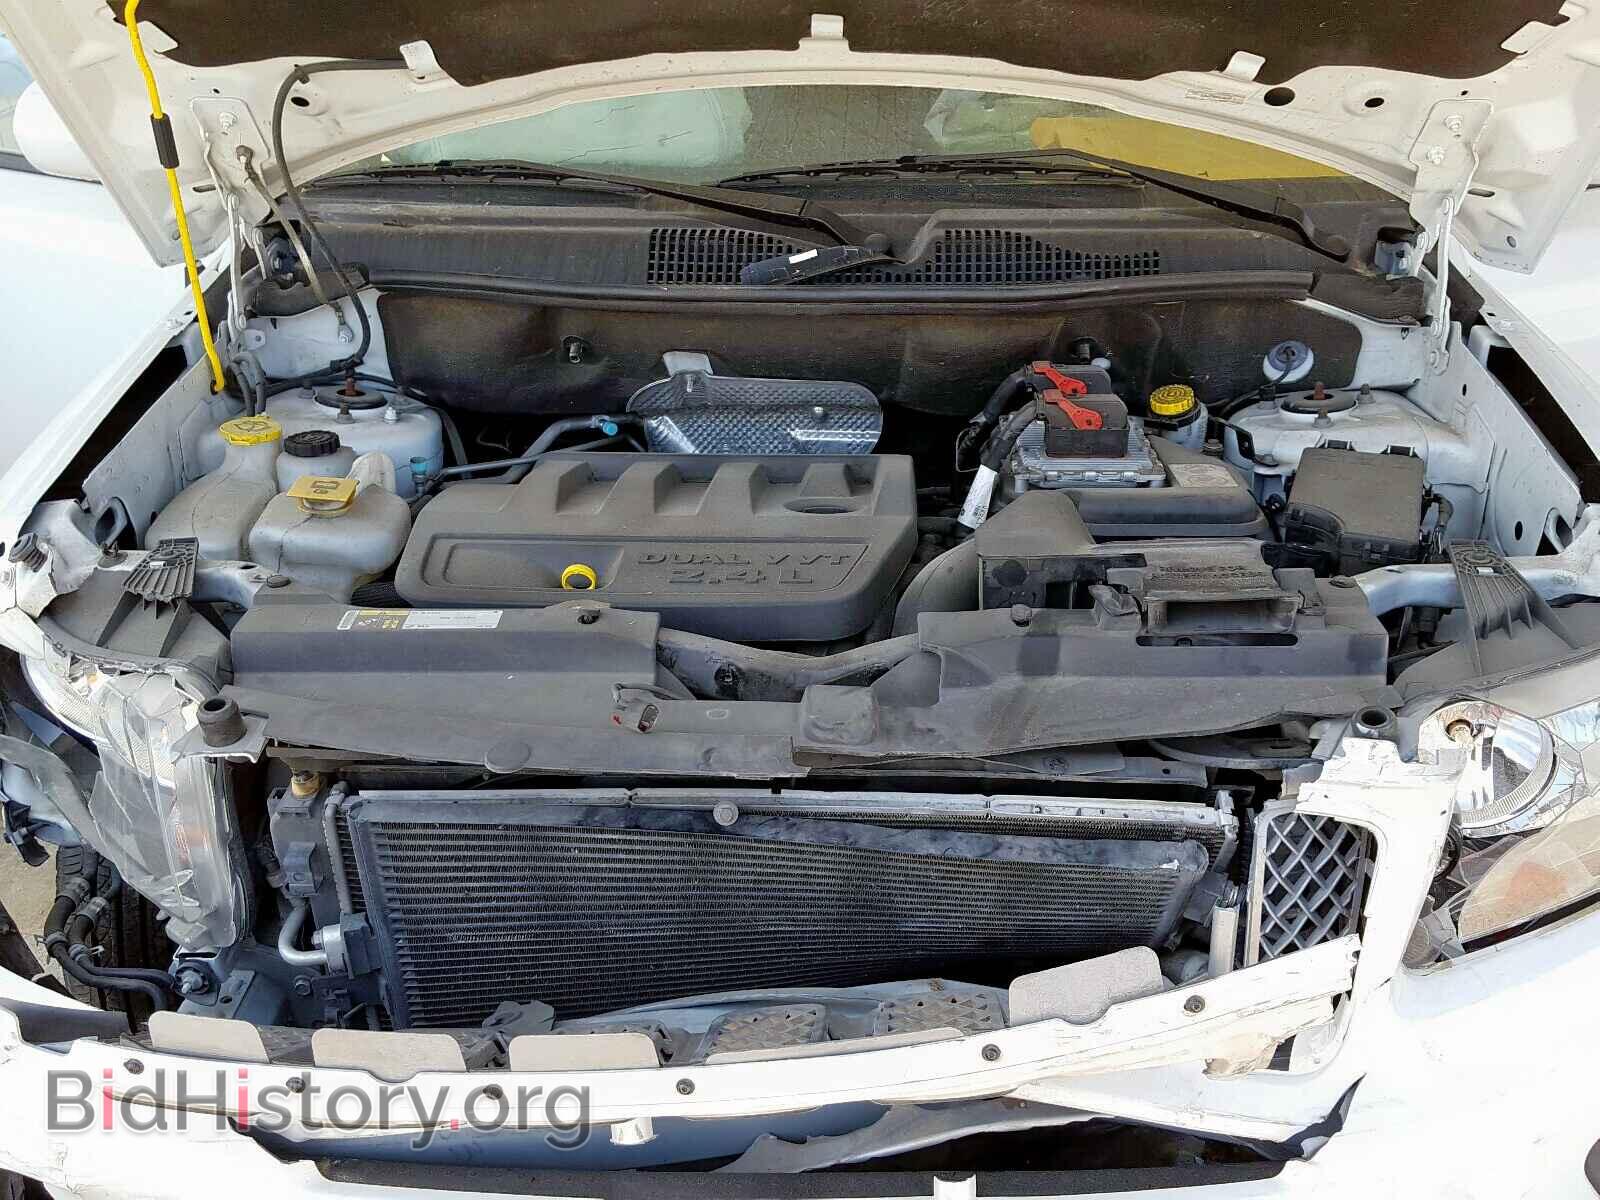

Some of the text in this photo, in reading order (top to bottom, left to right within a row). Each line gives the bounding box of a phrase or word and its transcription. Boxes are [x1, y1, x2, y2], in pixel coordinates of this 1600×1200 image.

[637, 552, 851, 566] DUAL VVT
[669, 567, 814, 585] 2.4L
